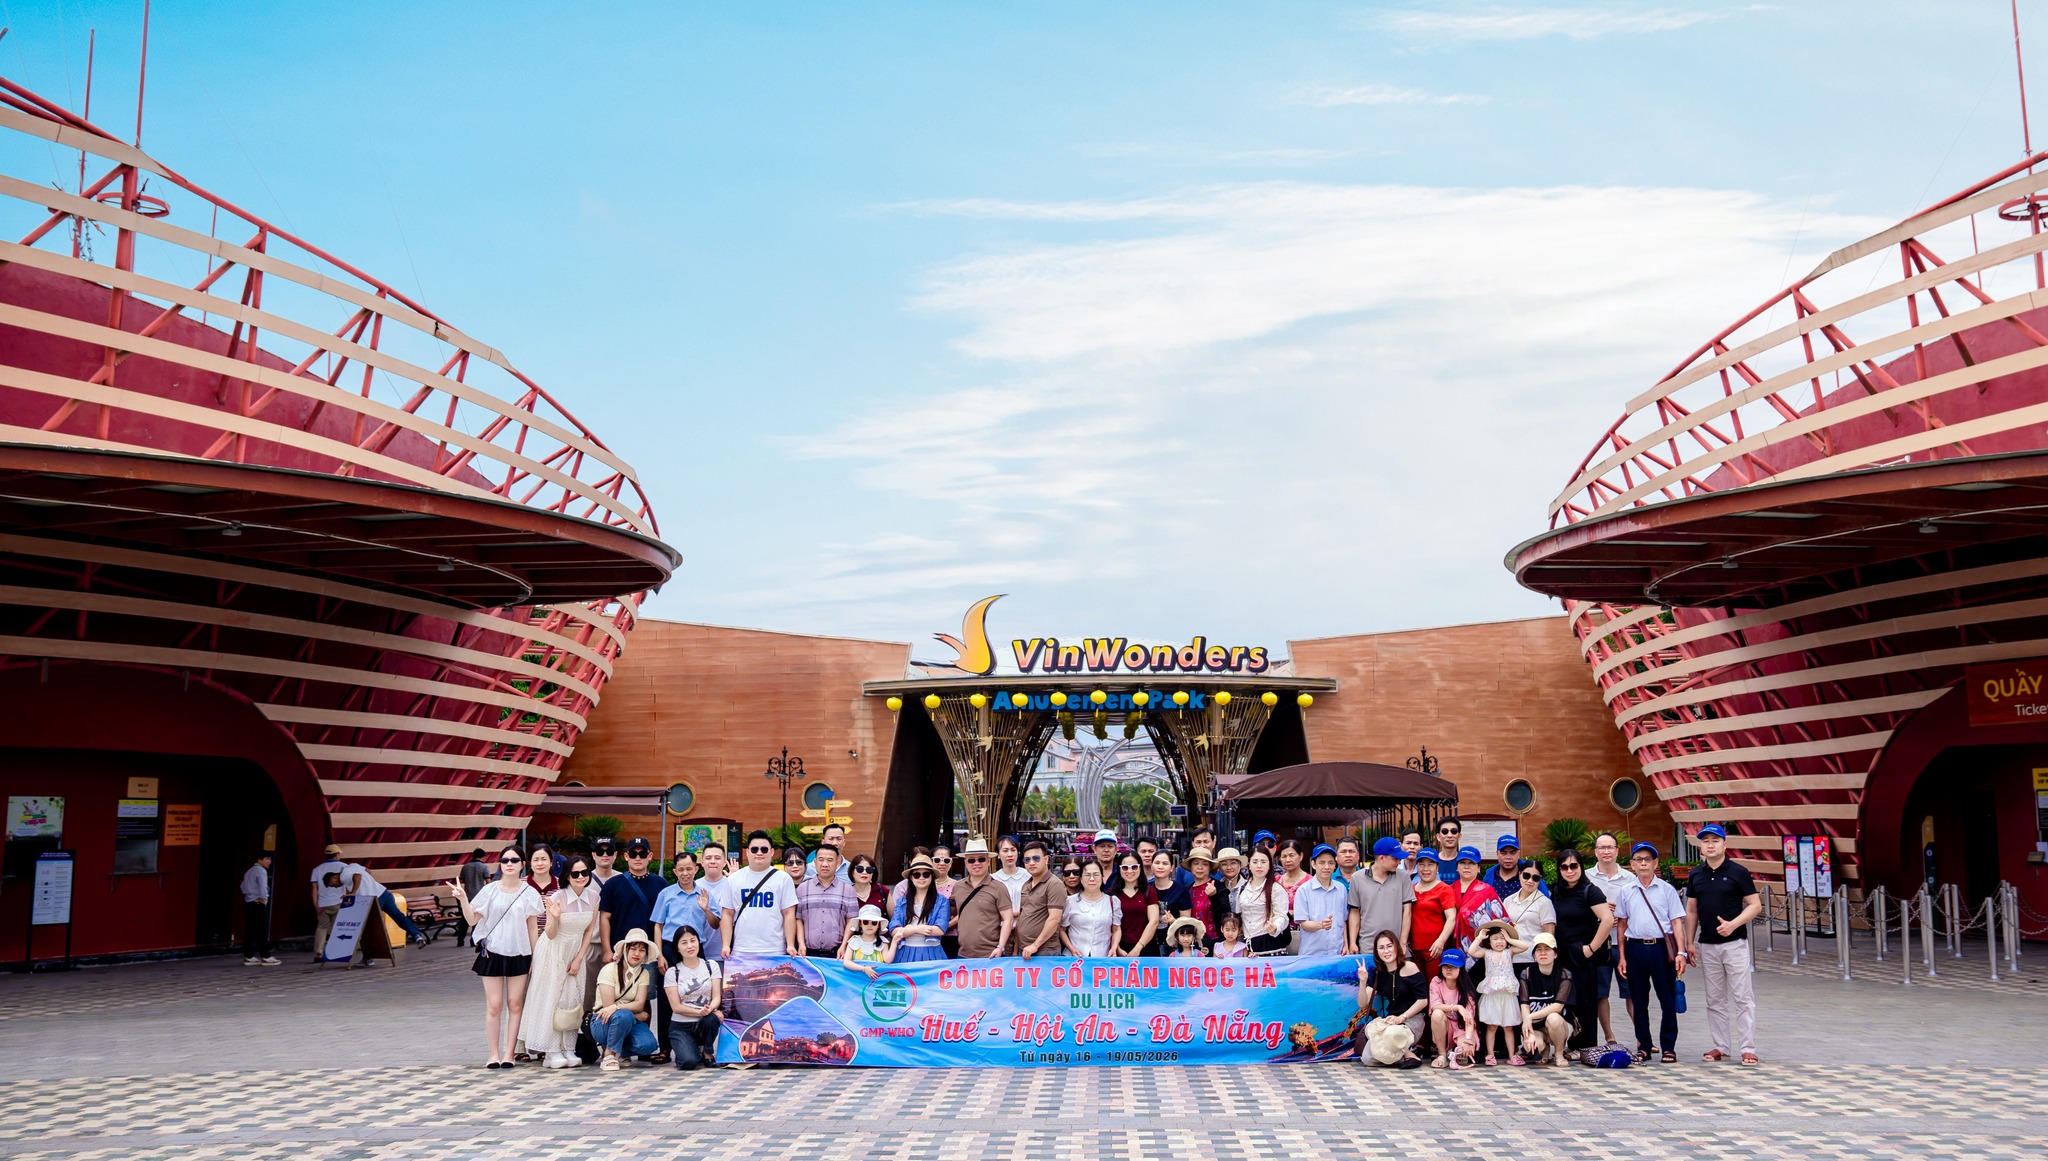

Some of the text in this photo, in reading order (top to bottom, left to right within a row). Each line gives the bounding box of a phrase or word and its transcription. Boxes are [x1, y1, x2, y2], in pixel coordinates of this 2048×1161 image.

[1011, 636, 1269, 673] VinWonders
[1983, 668, 2043, 702] QUẦY
[992, 690, 1206, 710] Auemen Pak
[938, 959, 1277, 993] CÔNG TY CỔ PHẦN NGỌC HÀ
[872, 989, 907, 1001] NH
[1070, 993, 1135, 1012] DU LỊCH
[860, 1027, 915, 1038] GMP-WHO
[919, 1009, 986, 1043] Huế
[1011, 1012, 1064, 1046] Hội
[1074, 1013, 1118, 1044] An
[1149, 1014, 1195, 1042] Đà
[1203, 1009, 1285, 1050] Nẵng
[1019, 1050, 1035, 1063] Từ
[1040, 1051, 1070, 1064] ngày
[1076, 1051, 1091, 1062] 16
[1106, 1051, 1178, 1062] 19/05/2026
